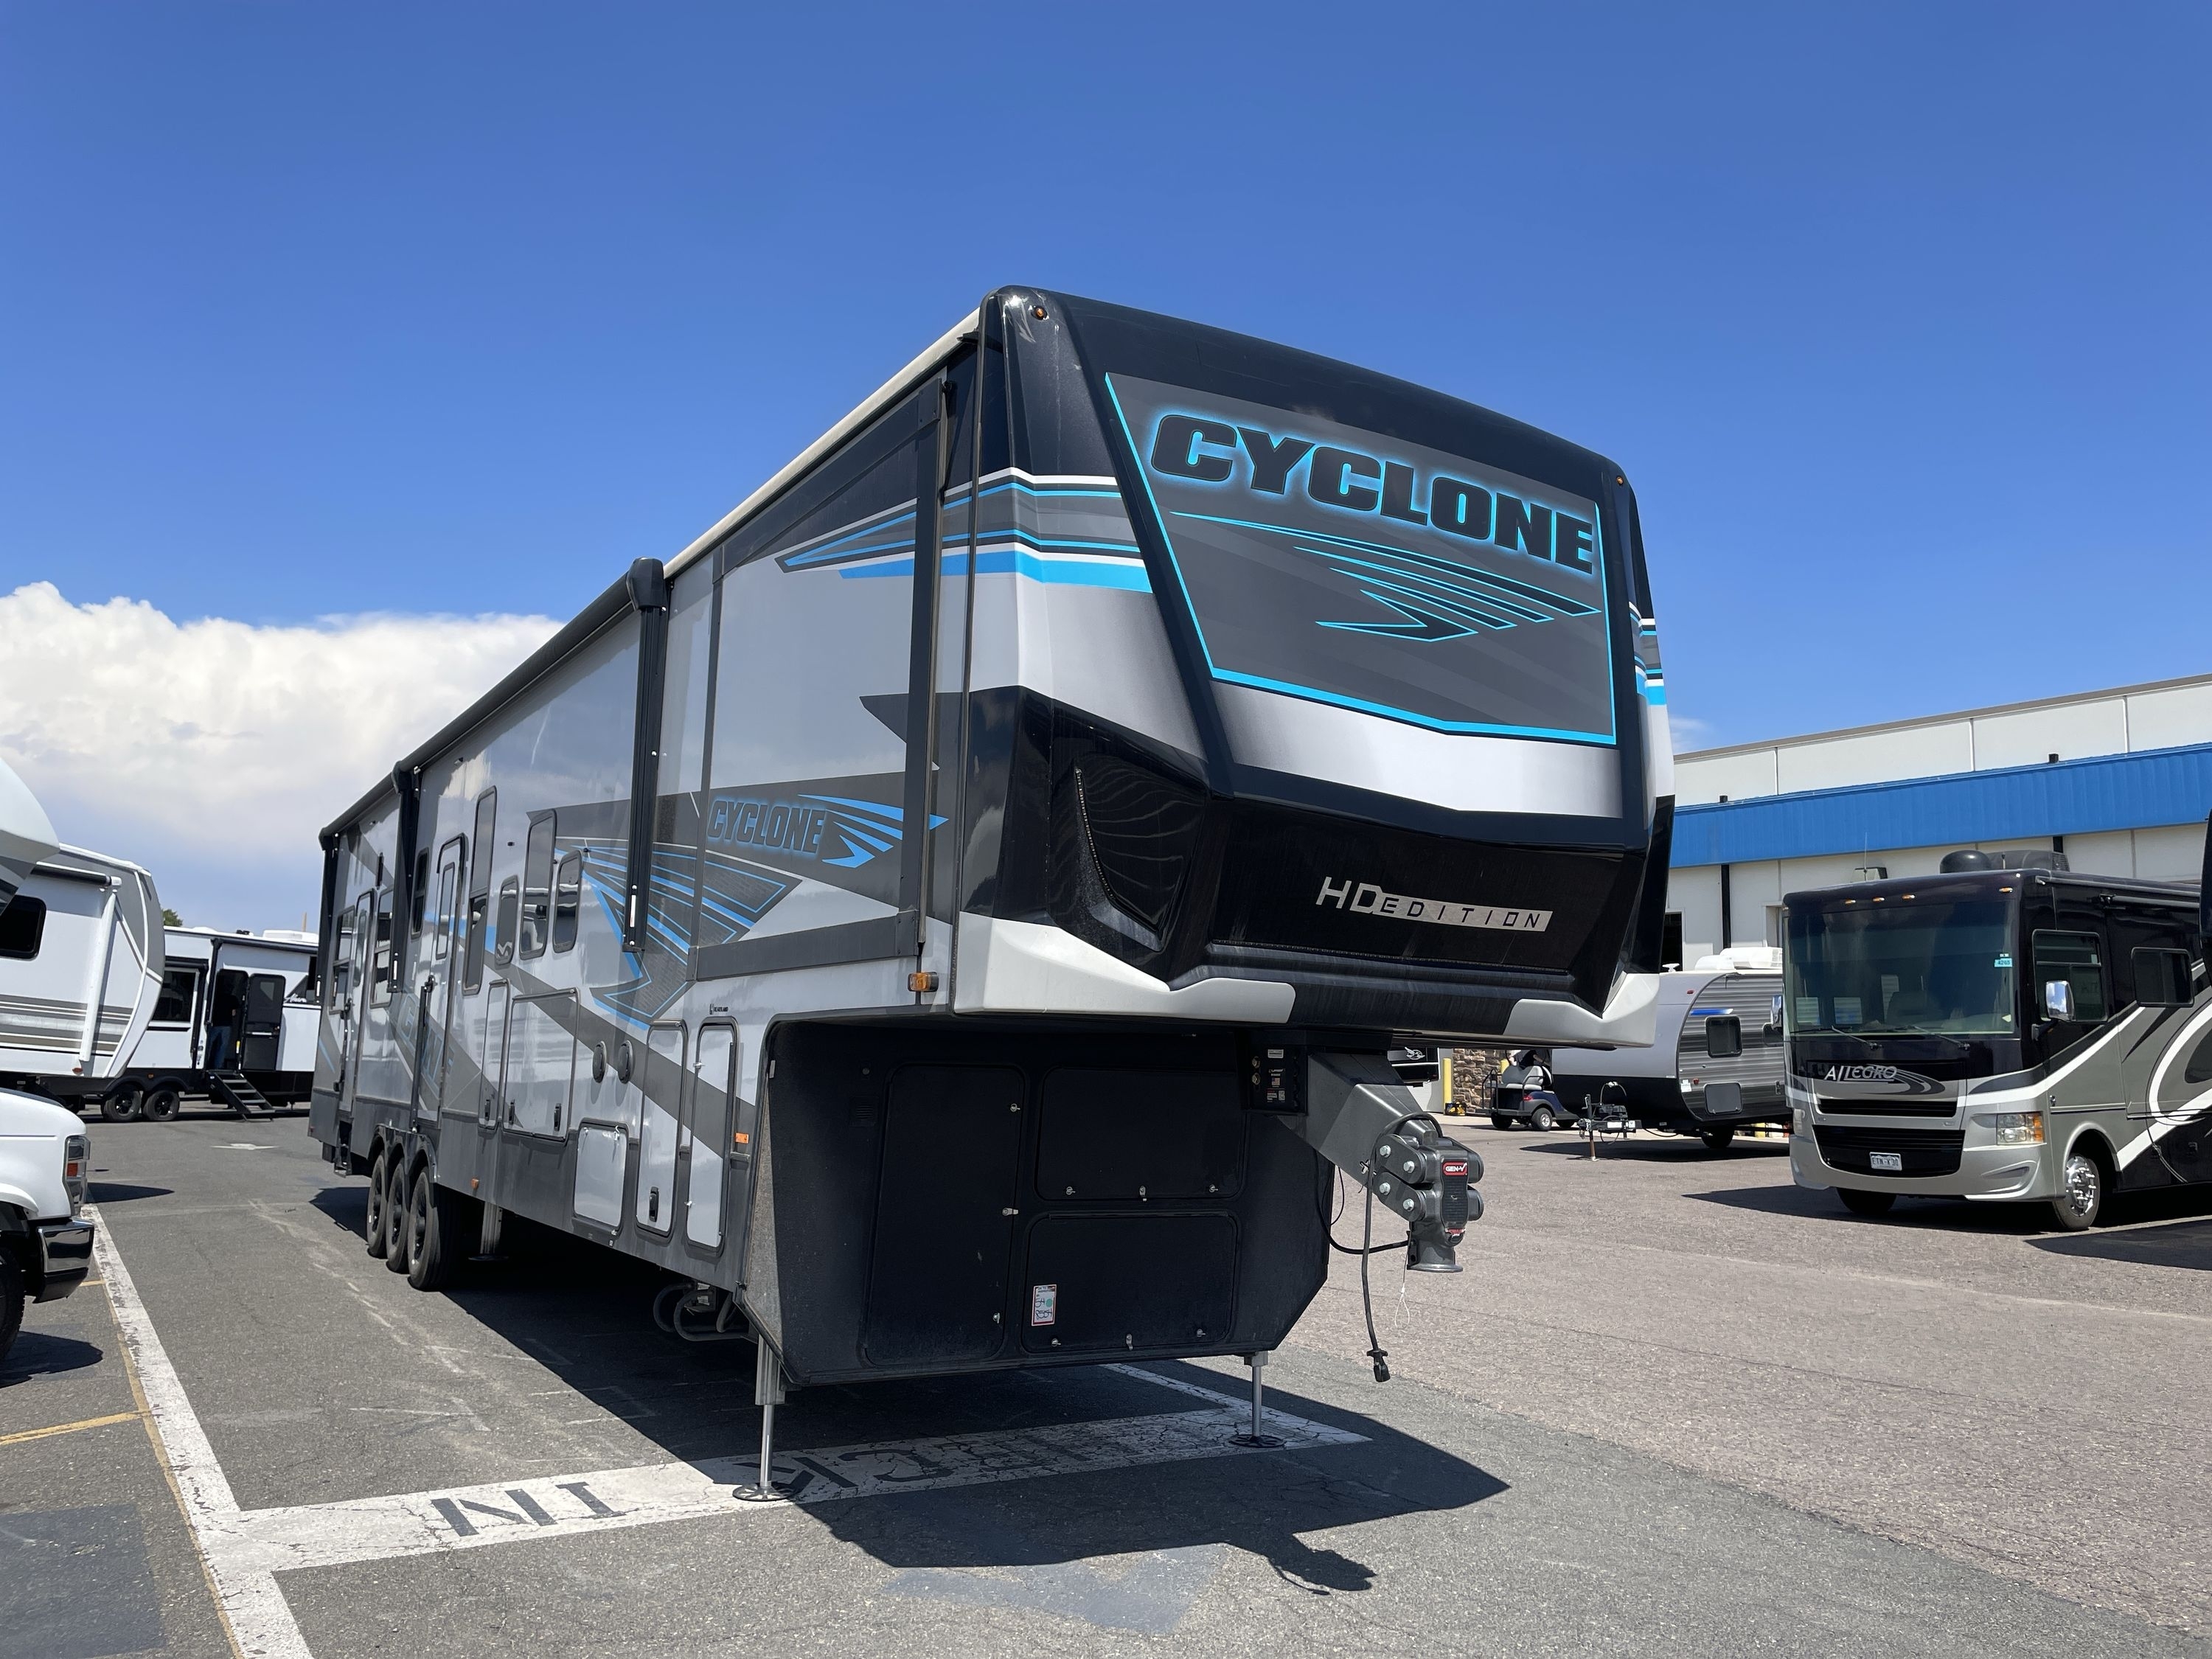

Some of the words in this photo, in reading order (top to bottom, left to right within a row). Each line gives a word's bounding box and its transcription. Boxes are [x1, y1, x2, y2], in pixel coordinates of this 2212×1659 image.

[1151, 414, 1593, 574] CYCLONE
[707, 800, 827, 854] CYCLONE
[1315, 876, 1383, 914] HD
[1380, 897, 1541, 929] EDITION
[1824, 1065, 1897, 1082] ALLEGRO
